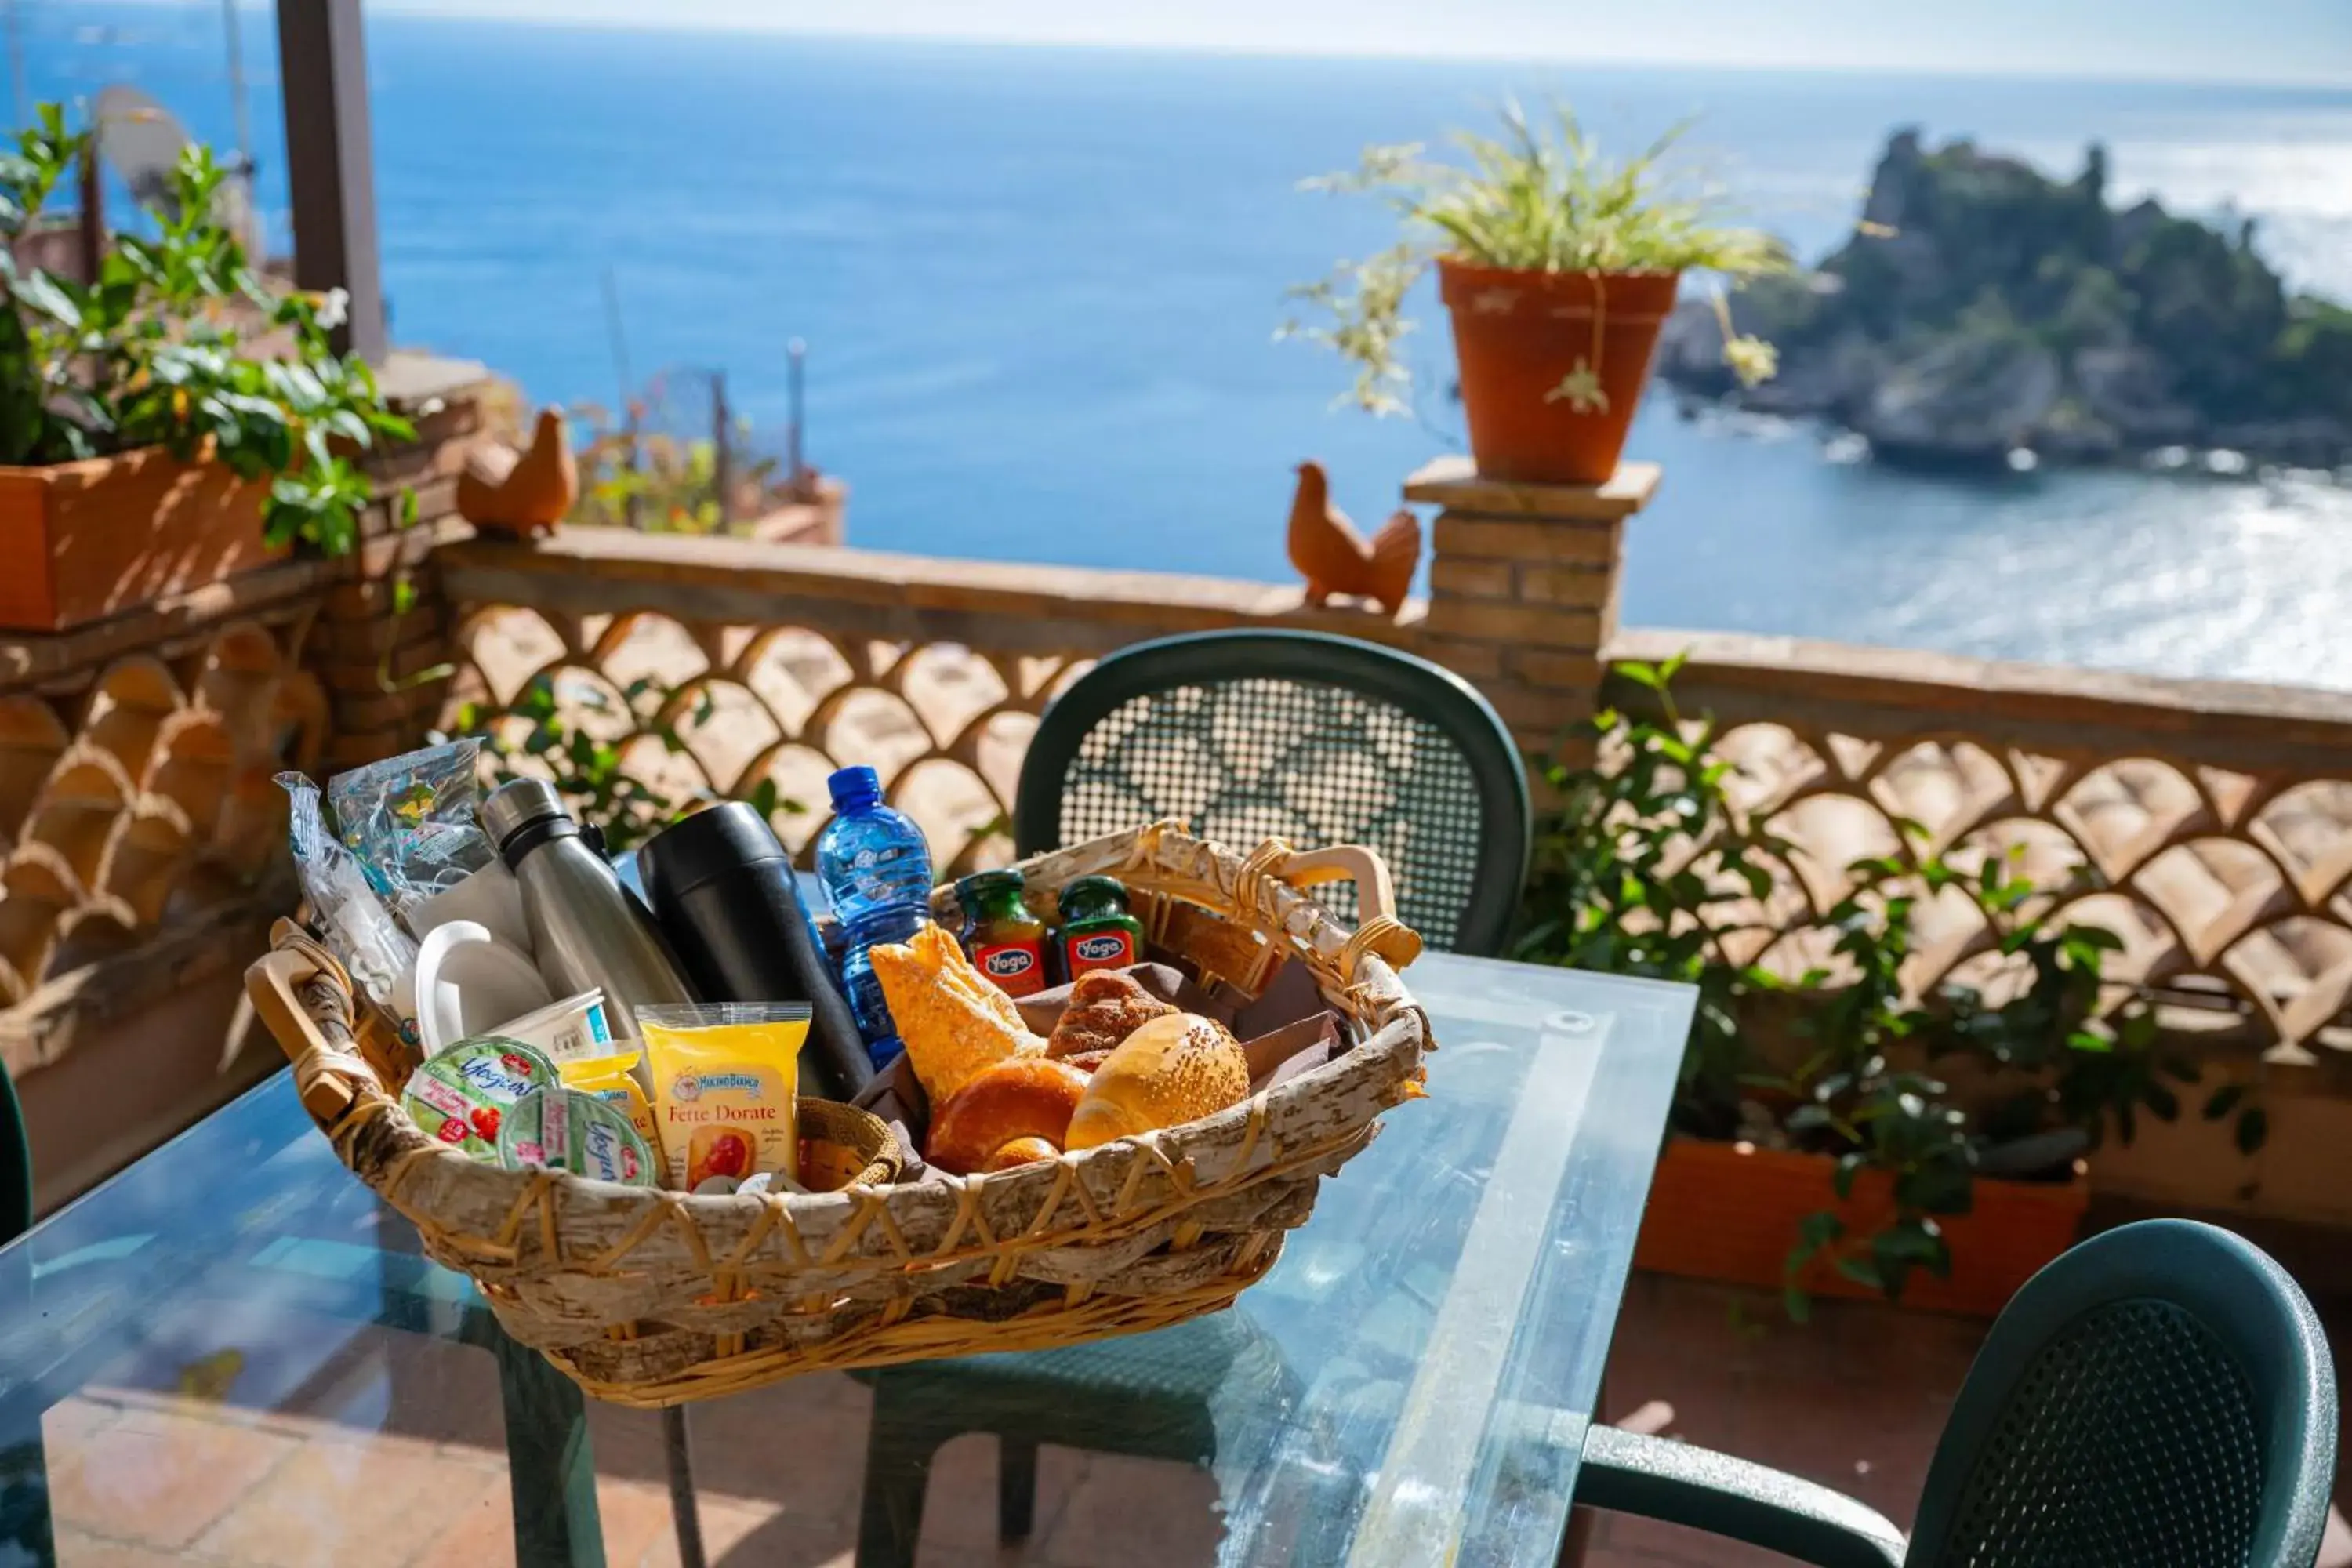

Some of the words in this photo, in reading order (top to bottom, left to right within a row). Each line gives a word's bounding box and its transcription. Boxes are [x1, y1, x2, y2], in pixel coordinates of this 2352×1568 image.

[1077, 941, 1120, 956] Yoga
[986, 954, 1029, 972] Yoga
[669, 1105, 710, 1122] Fette
[716, 1105, 776, 1122] Dorate
